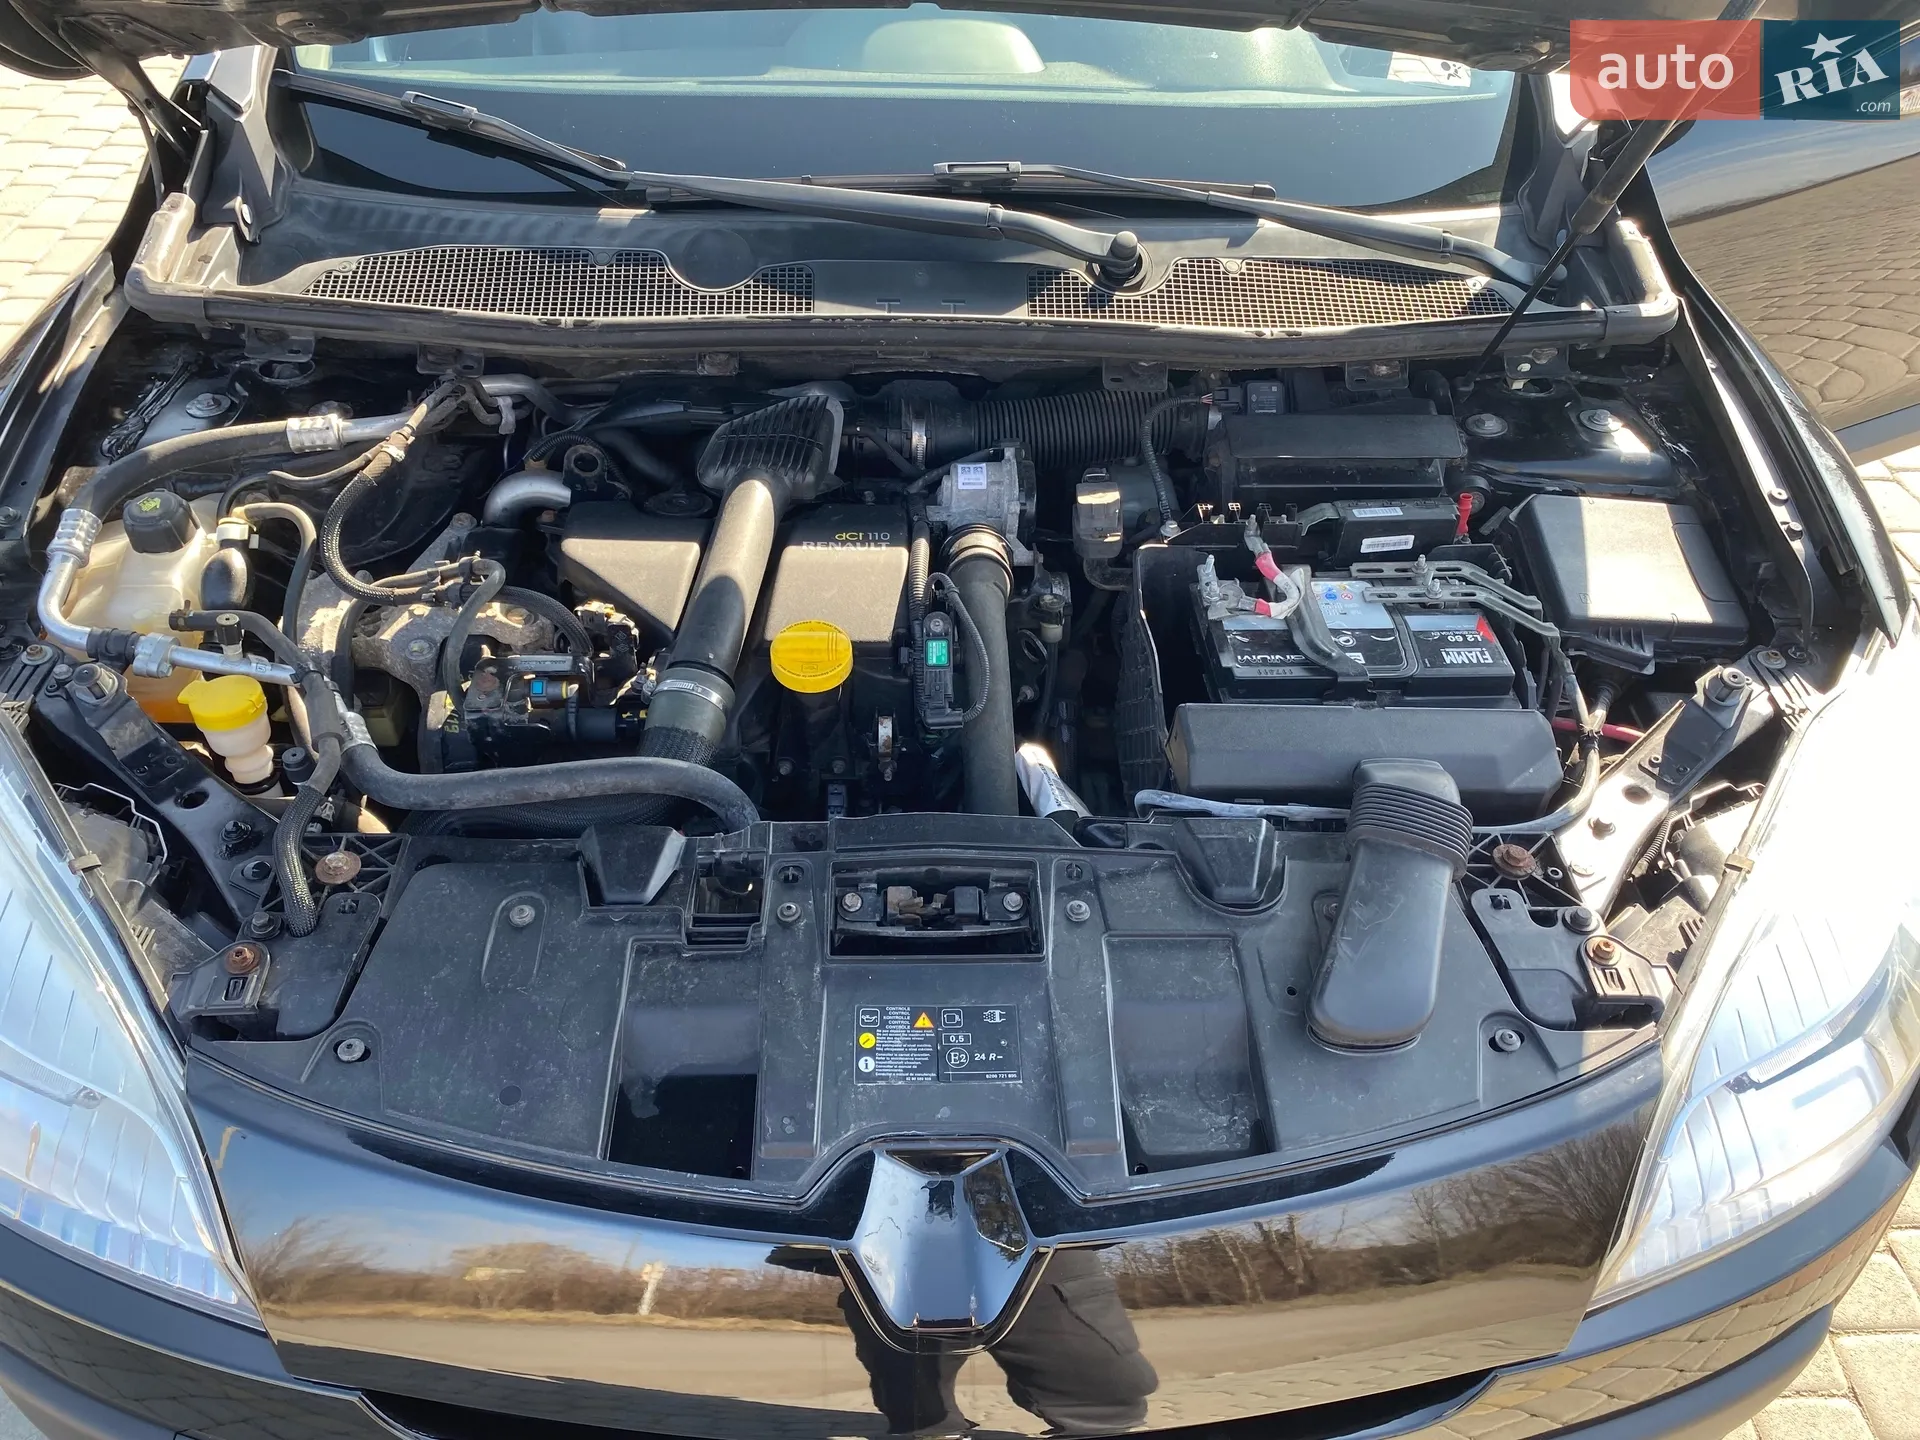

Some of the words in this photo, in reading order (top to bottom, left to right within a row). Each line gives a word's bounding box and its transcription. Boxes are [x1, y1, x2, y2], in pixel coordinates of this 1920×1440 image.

[867, 532, 890, 541] 110
[802, 540, 890, 551] RENAULT
[1465, 634, 1482, 642] L2
[1441, 651, 1494, 664] FIAMM
[949, 1035, 965, 1043] 0,5
[949, 1052, 967, 1064] E2
[974, 1053, 987, 1061] 24
